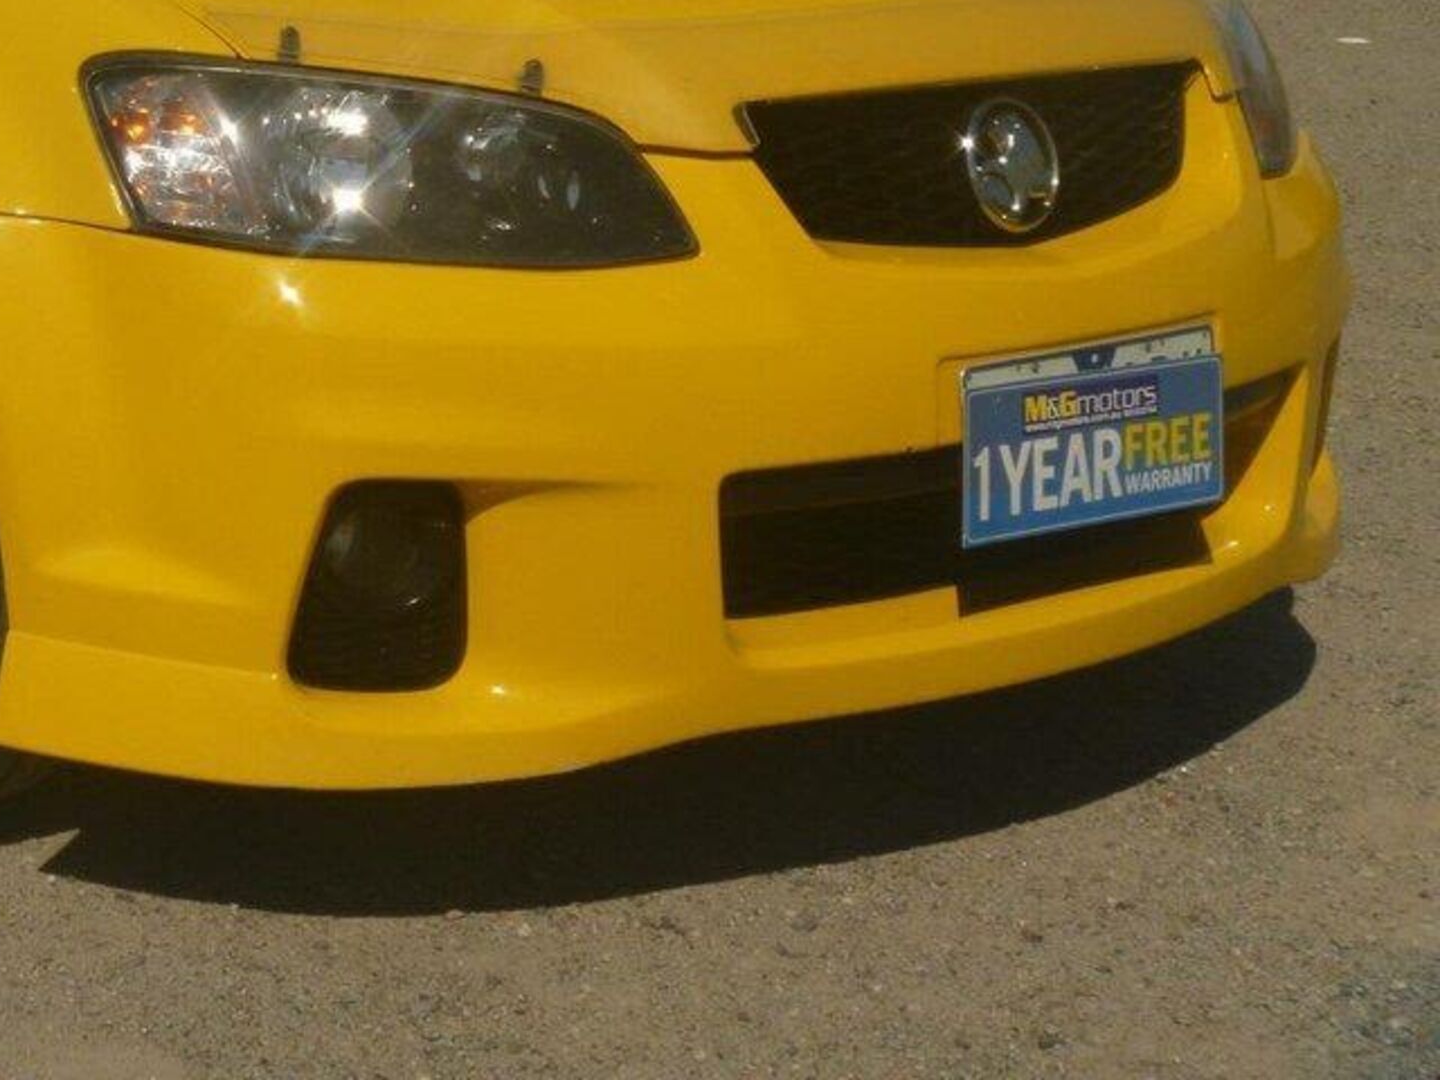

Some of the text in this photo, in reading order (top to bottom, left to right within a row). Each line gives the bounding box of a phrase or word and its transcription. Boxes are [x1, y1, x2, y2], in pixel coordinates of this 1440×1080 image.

[973, 413, 1210, 521] 1 YEAR FREE
[1124, 461, 1212, 496] WARRANTY
